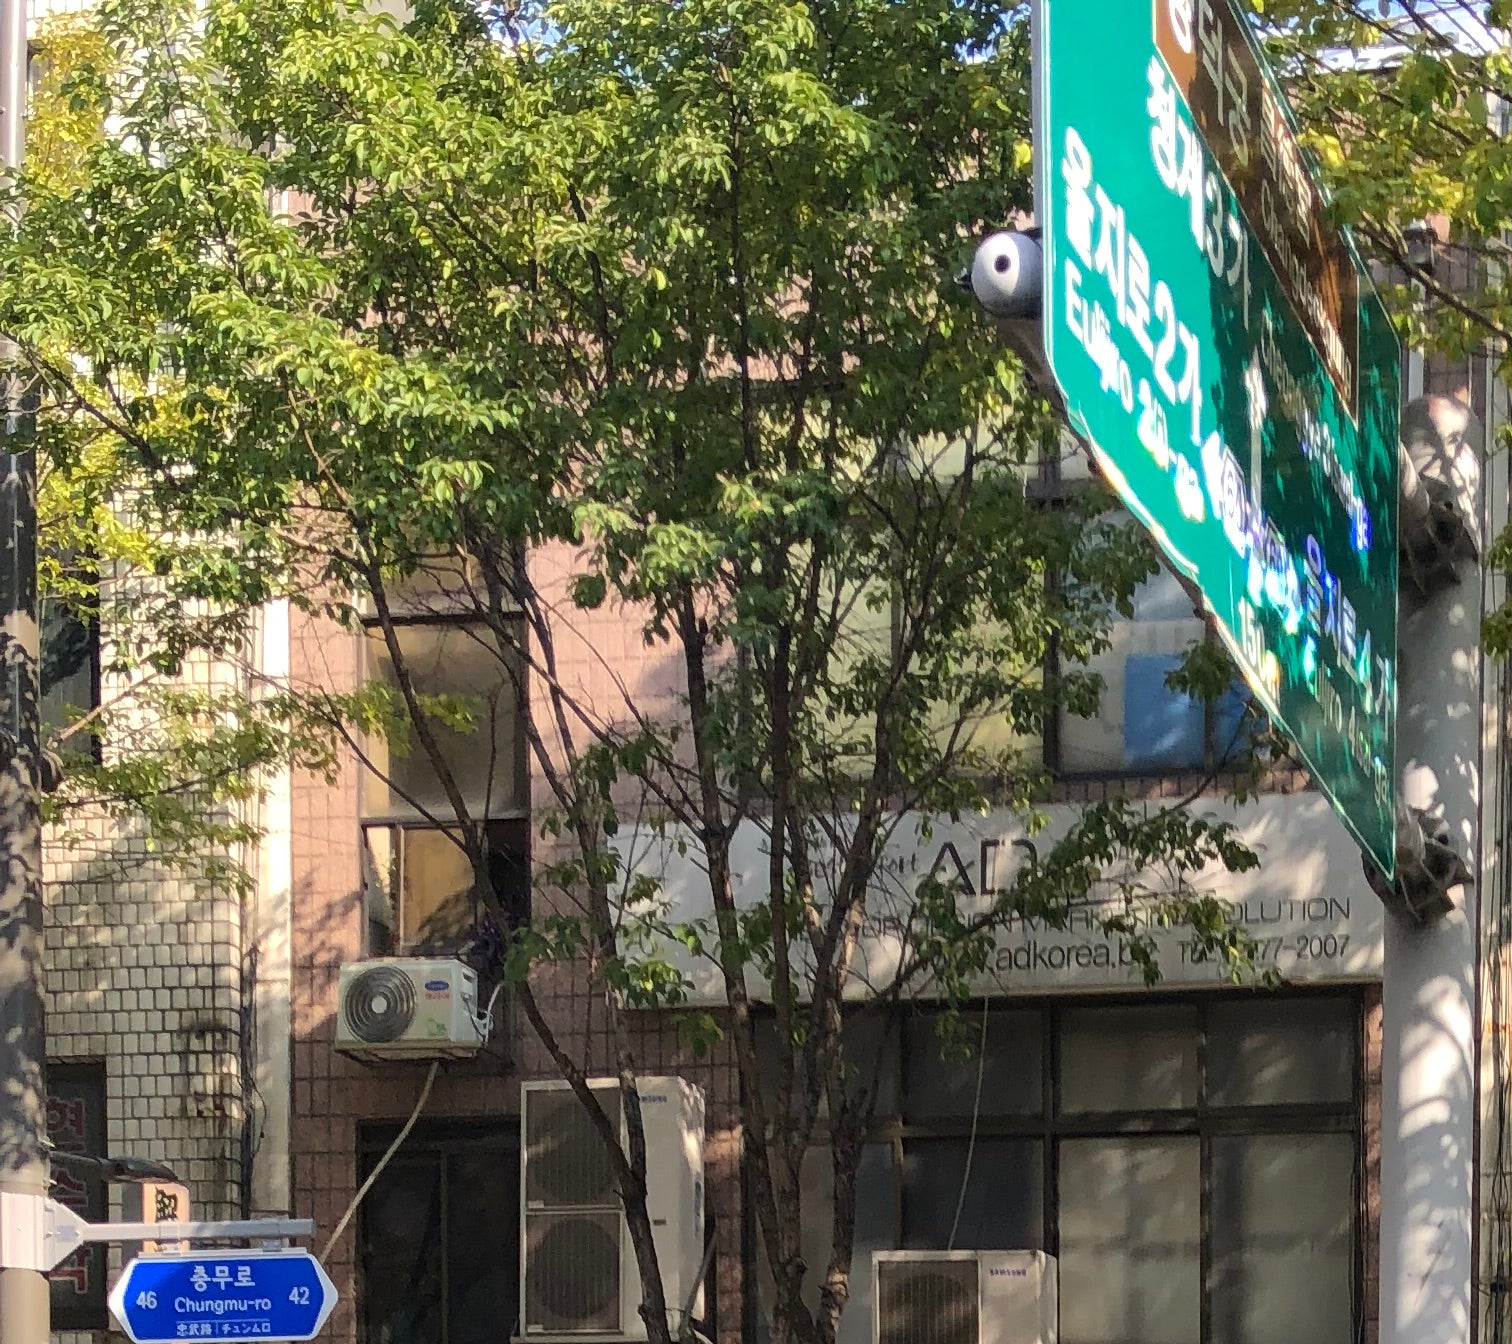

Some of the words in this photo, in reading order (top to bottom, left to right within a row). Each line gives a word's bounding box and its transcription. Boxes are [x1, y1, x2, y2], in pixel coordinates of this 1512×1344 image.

[1061, 126, 1203, 448] 을지로2가
[1146, 55, 1251, 333] 청계3가
[1303, 533, 1392, 744] 을지로4가
[136, 1290, 158, 1311] 46
[174, 1296, 272, 1316] Chungmu-ro
[288, 1286, 311, 1306] 42
[190, 1264, 256, 1293] 충무로
